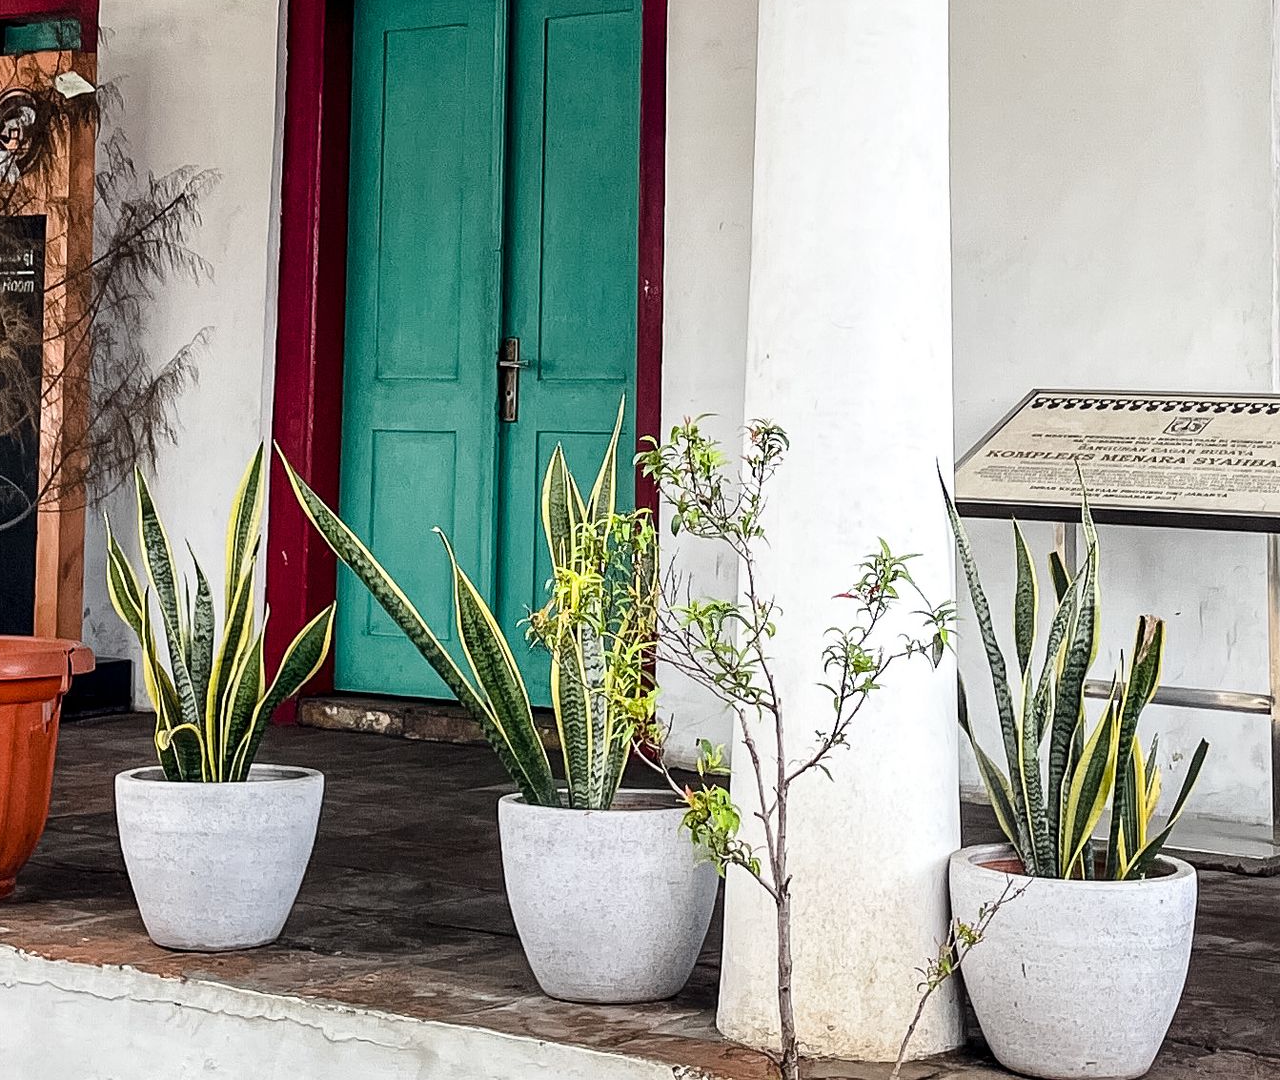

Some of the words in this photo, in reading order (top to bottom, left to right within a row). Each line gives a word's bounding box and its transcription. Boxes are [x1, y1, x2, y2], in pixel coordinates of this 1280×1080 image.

[2, 279, 34, 292] Room
[985, 449, 1095, 461] KOMPLEKS
[1100, 453, 1185, 464] MENARA
[1077, 444, 1148, 453] BANGUNAN
[1150, 446, 1196, 454] CAGAR
[1200, 448, 1254, 456] BUDAYA
